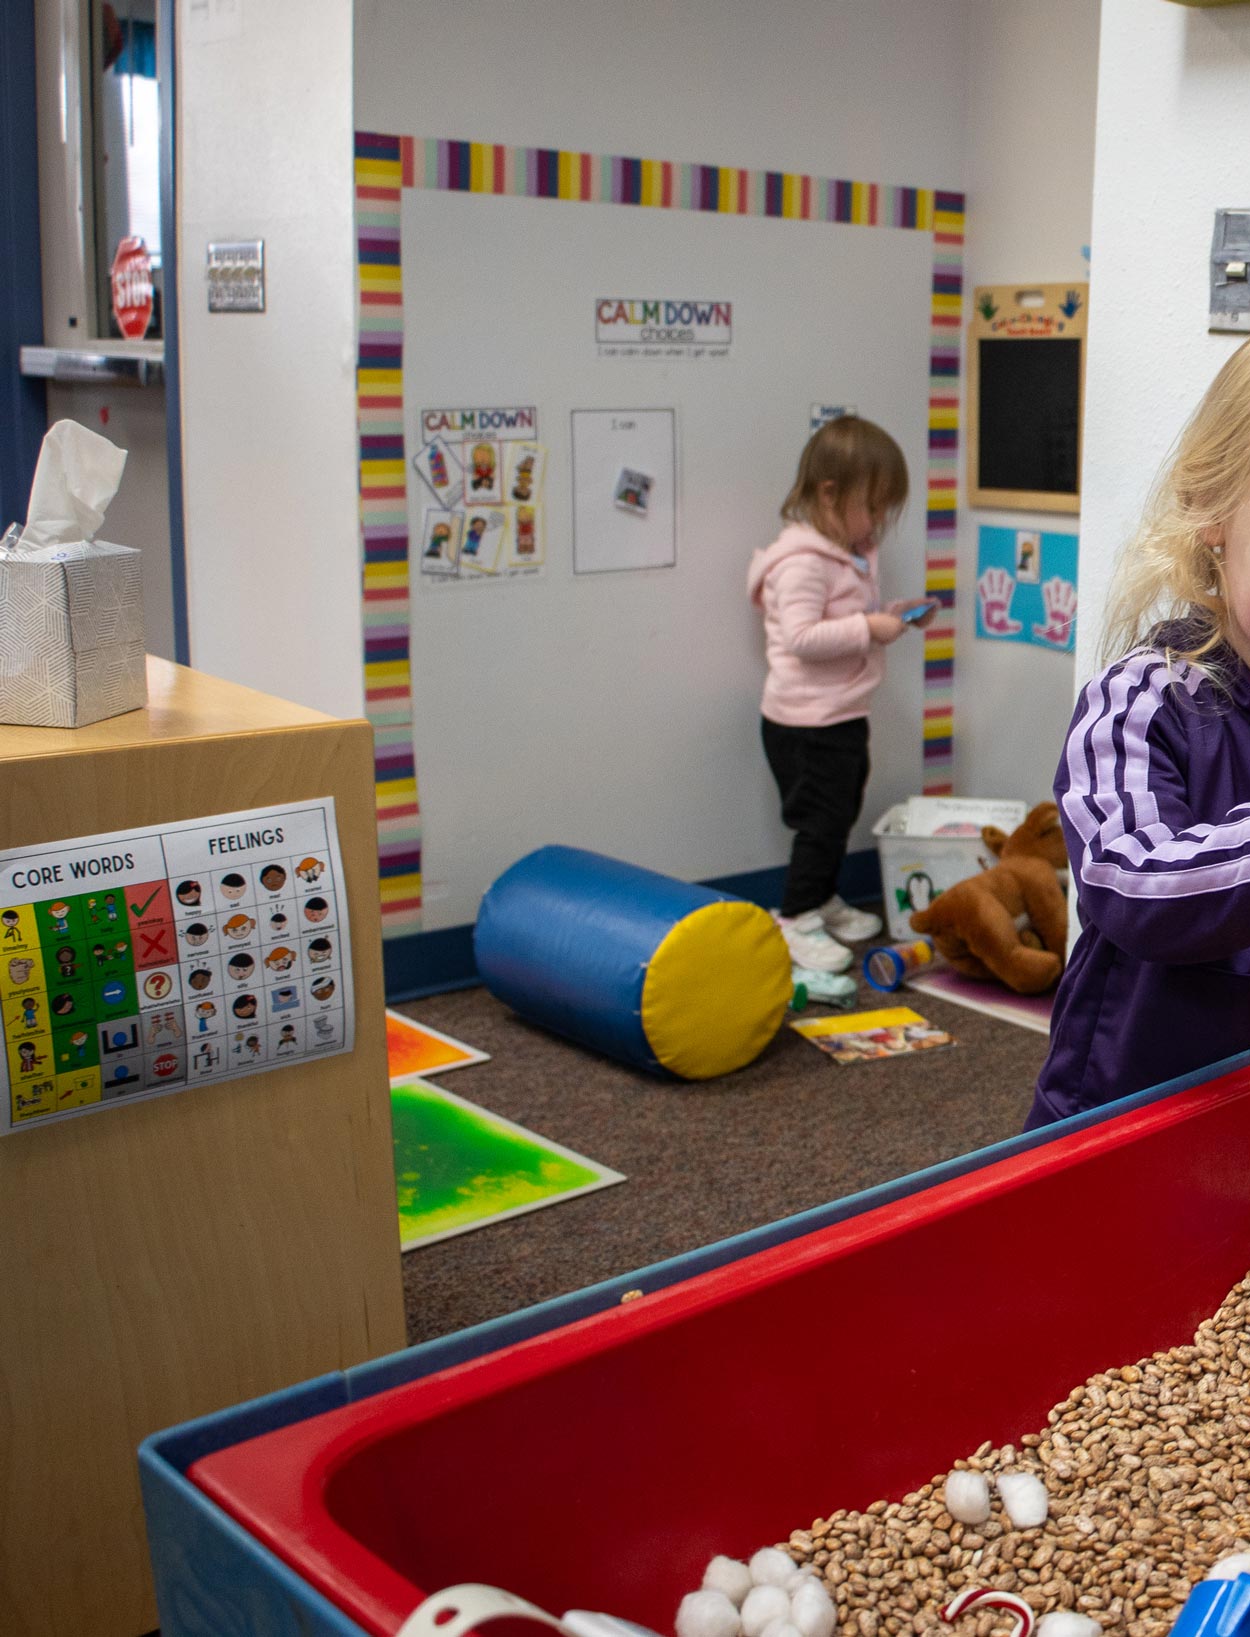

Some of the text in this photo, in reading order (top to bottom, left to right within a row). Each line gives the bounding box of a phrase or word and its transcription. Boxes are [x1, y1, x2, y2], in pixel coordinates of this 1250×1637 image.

[116, 270, 150, 308] STOP
[598, 300, 732, 326] CALM DOWN
[640, 327, 695, 341] choices
[425, 408, 533, 431] CALM DOWN
[208, 827, 285, 855] FEELINGS
[12, 853, 136, 889] CORE WORDS
[153, 1060, 178, 1073] STOP
